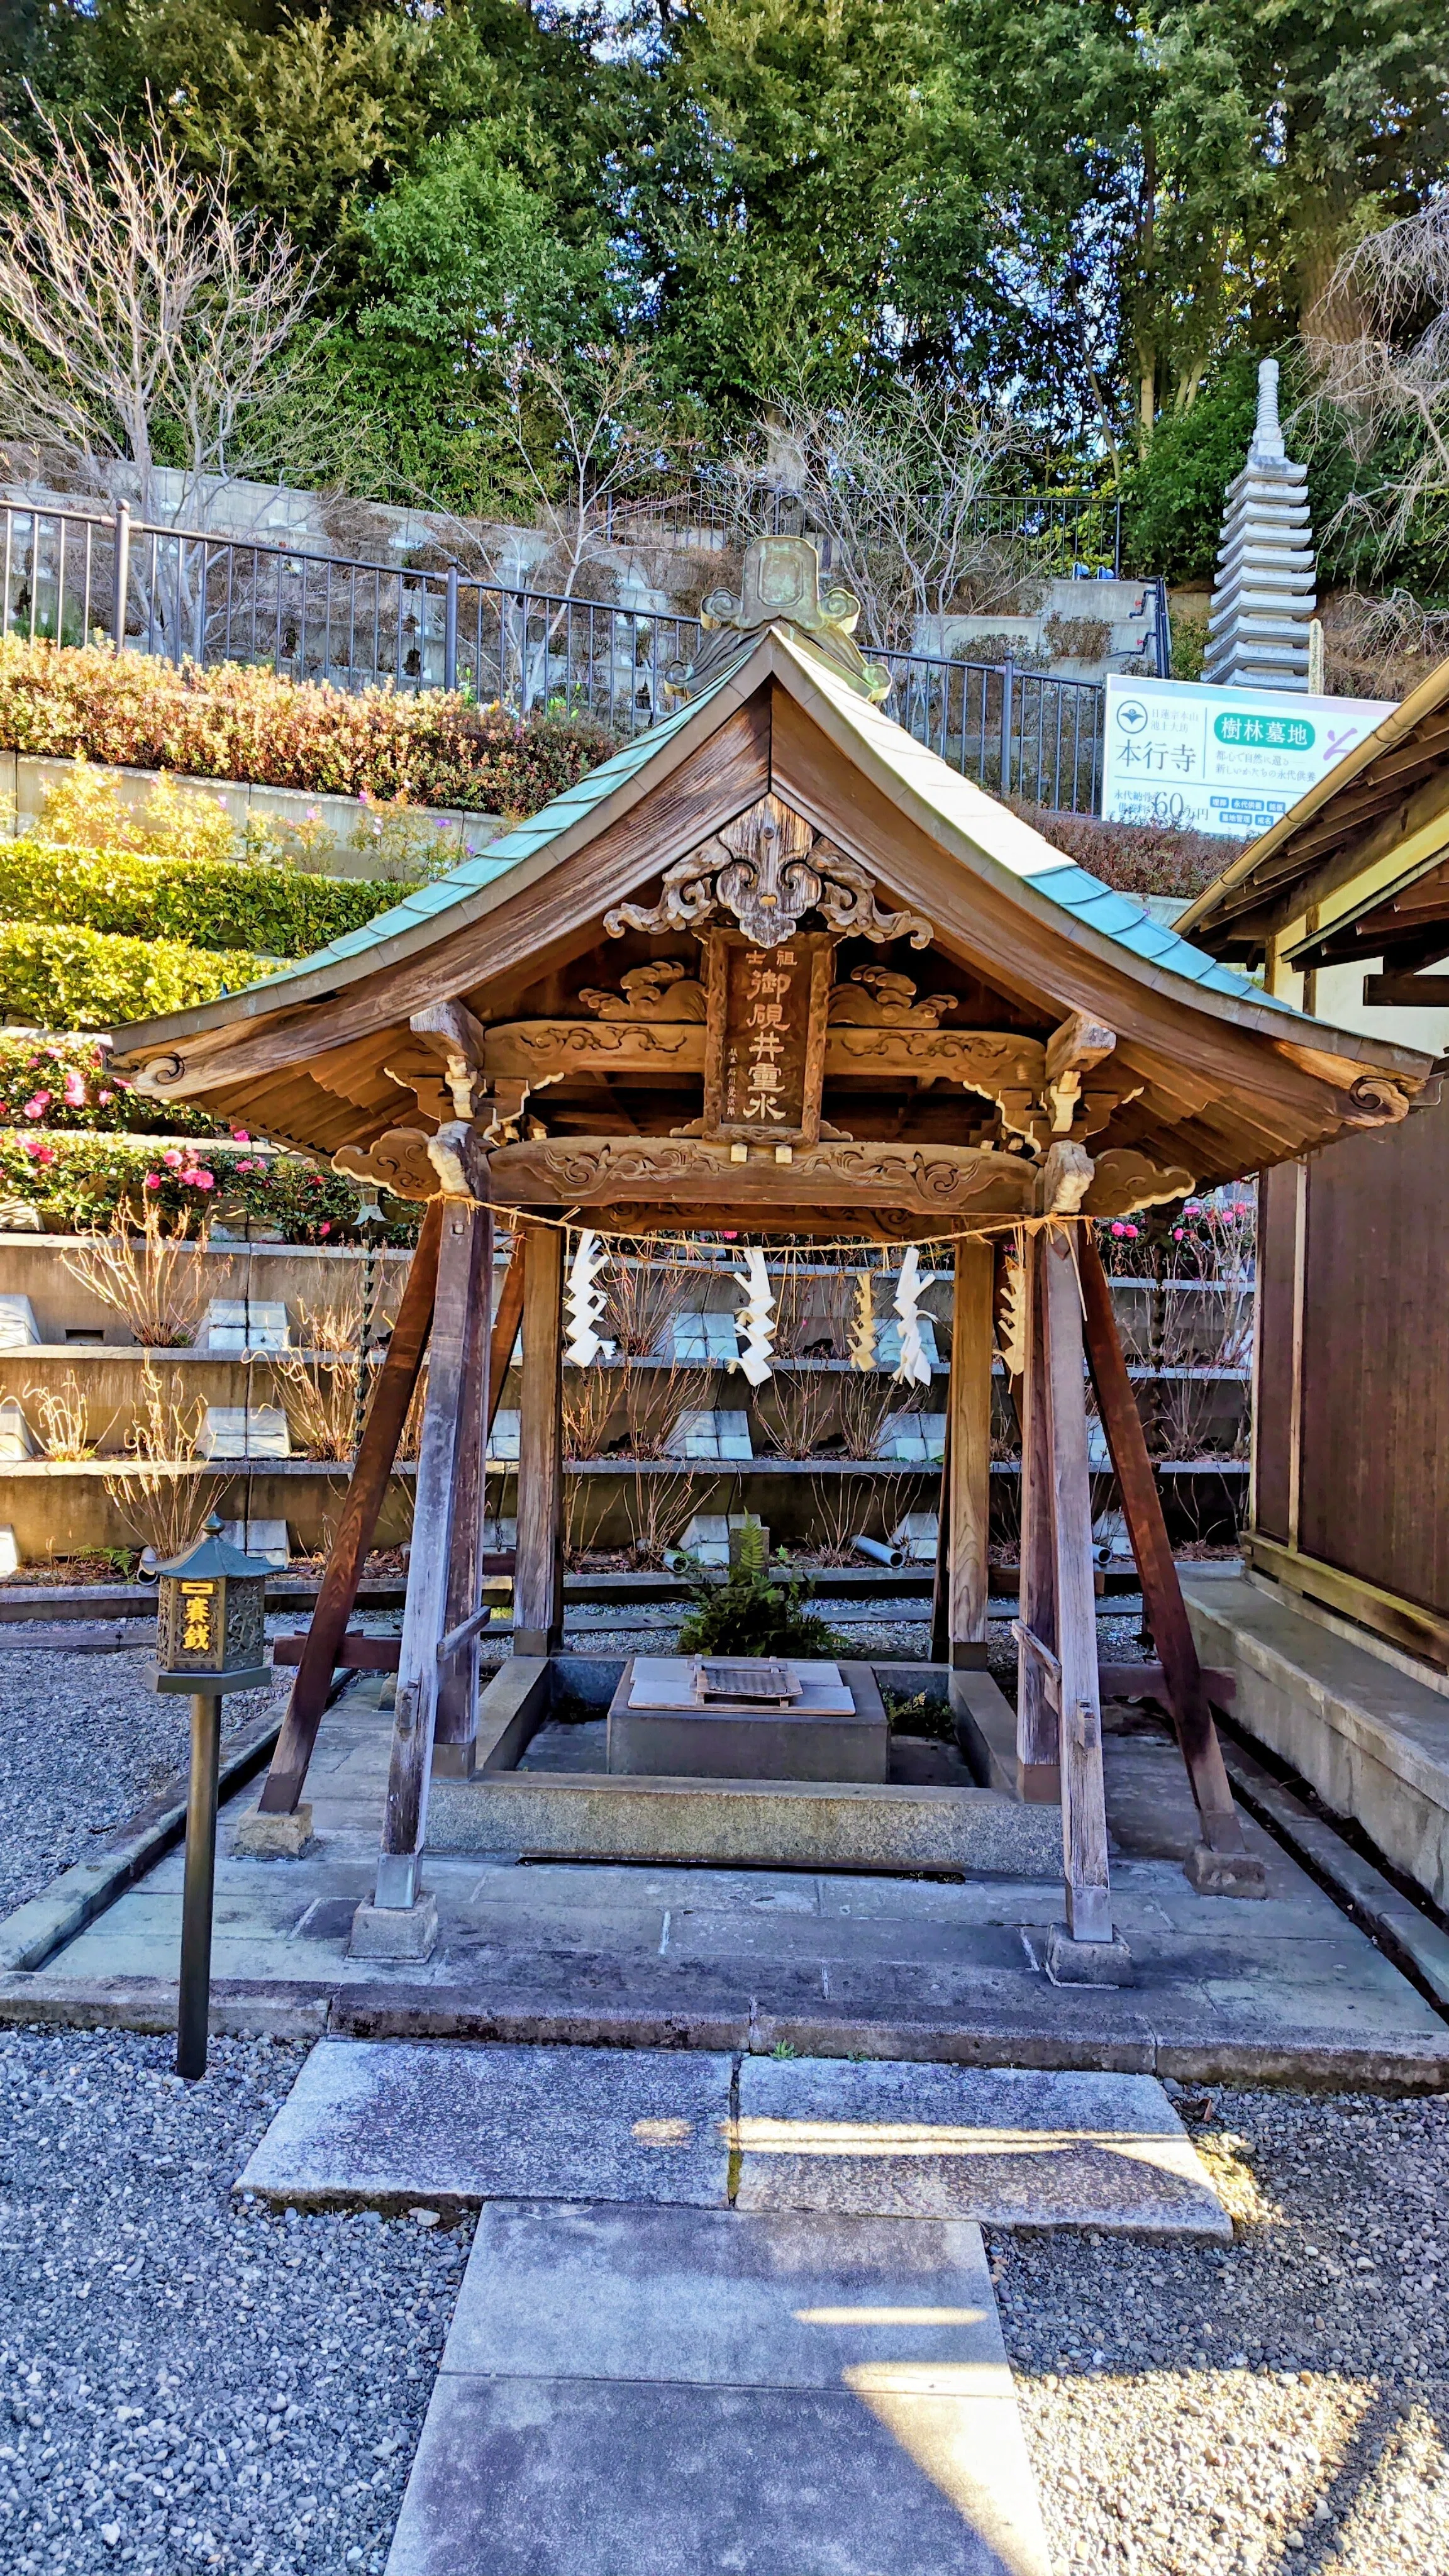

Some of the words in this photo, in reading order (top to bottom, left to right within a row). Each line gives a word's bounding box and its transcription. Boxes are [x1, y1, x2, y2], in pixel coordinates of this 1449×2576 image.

[1221, 716, 1308, 745] 樹林墓地
[1116, 738, 1197, 772] 本行寺
[1215, 763, 1316, 782] 新しいかたちの永代供養
[182, 1596, 210, 1651] 賽銭
